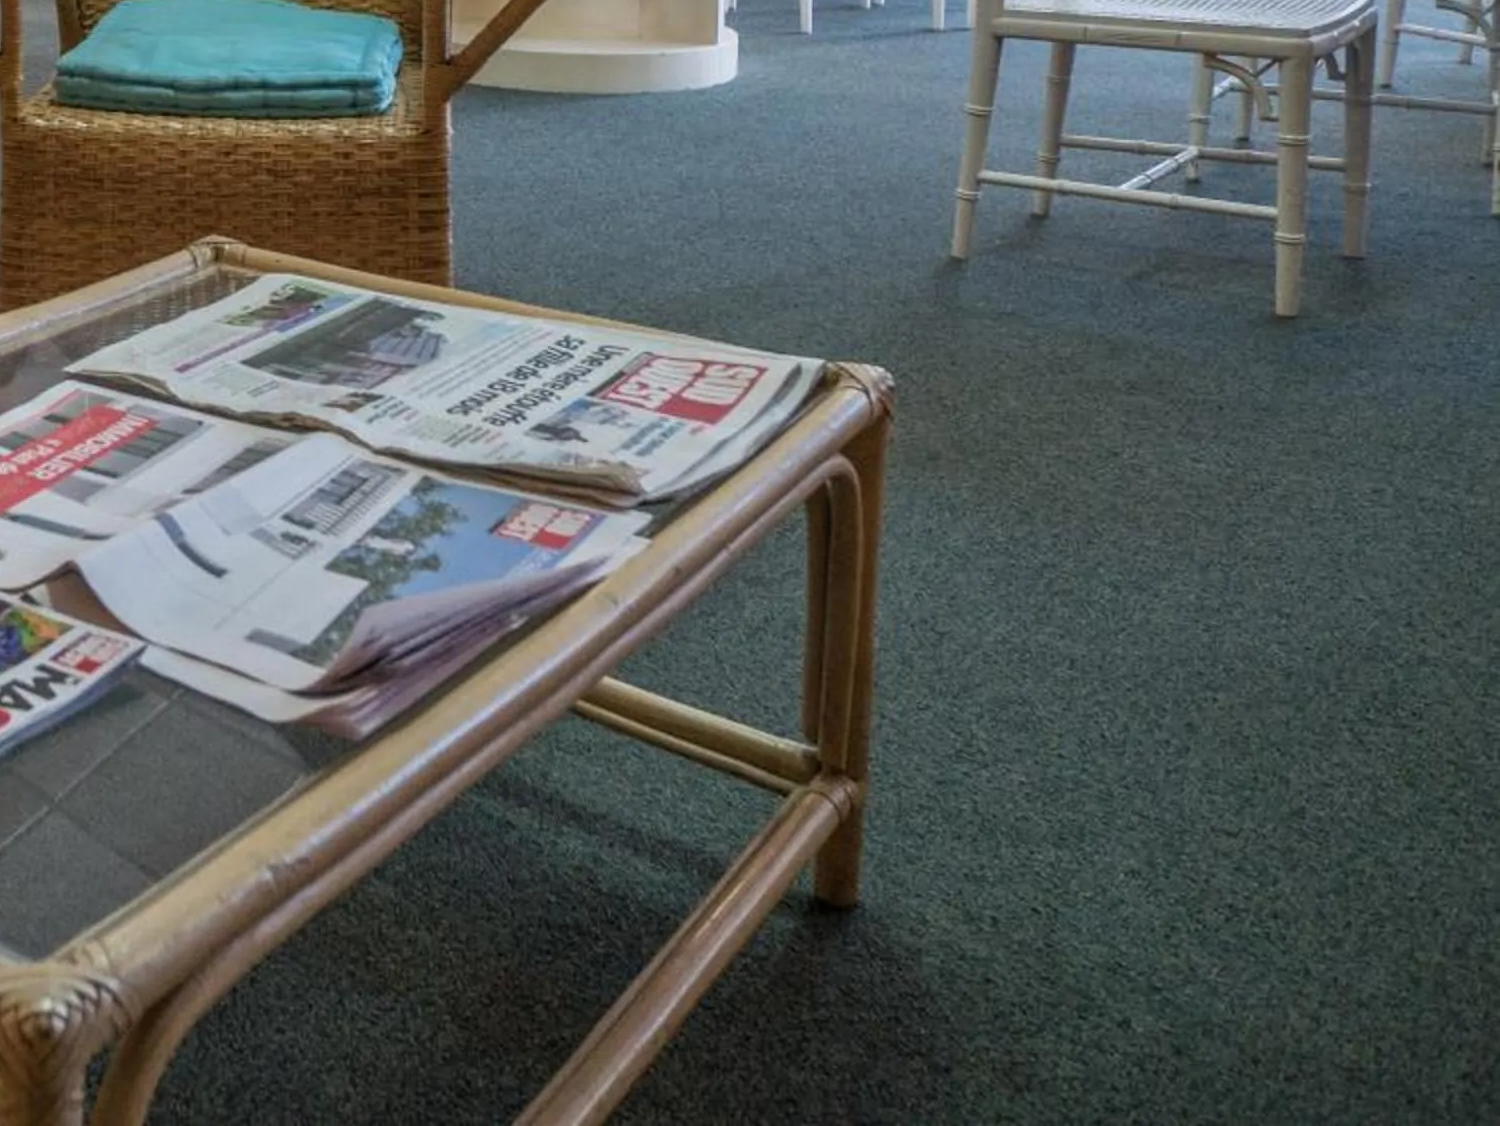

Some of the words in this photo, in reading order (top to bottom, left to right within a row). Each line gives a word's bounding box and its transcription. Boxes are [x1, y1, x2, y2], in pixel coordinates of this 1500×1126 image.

[554, 334, 587, 351] sa
[579, 344, 631, 368] Une
[505, 364, 542, 381] de
[606, 355, 705, 410] OUEST
[678, 361, 762, 406] SUD
[487, 378, 526, 394] 18
[446, 389, 499, 416] mois
[27, 411, 150, 481] IMMOBILIER
